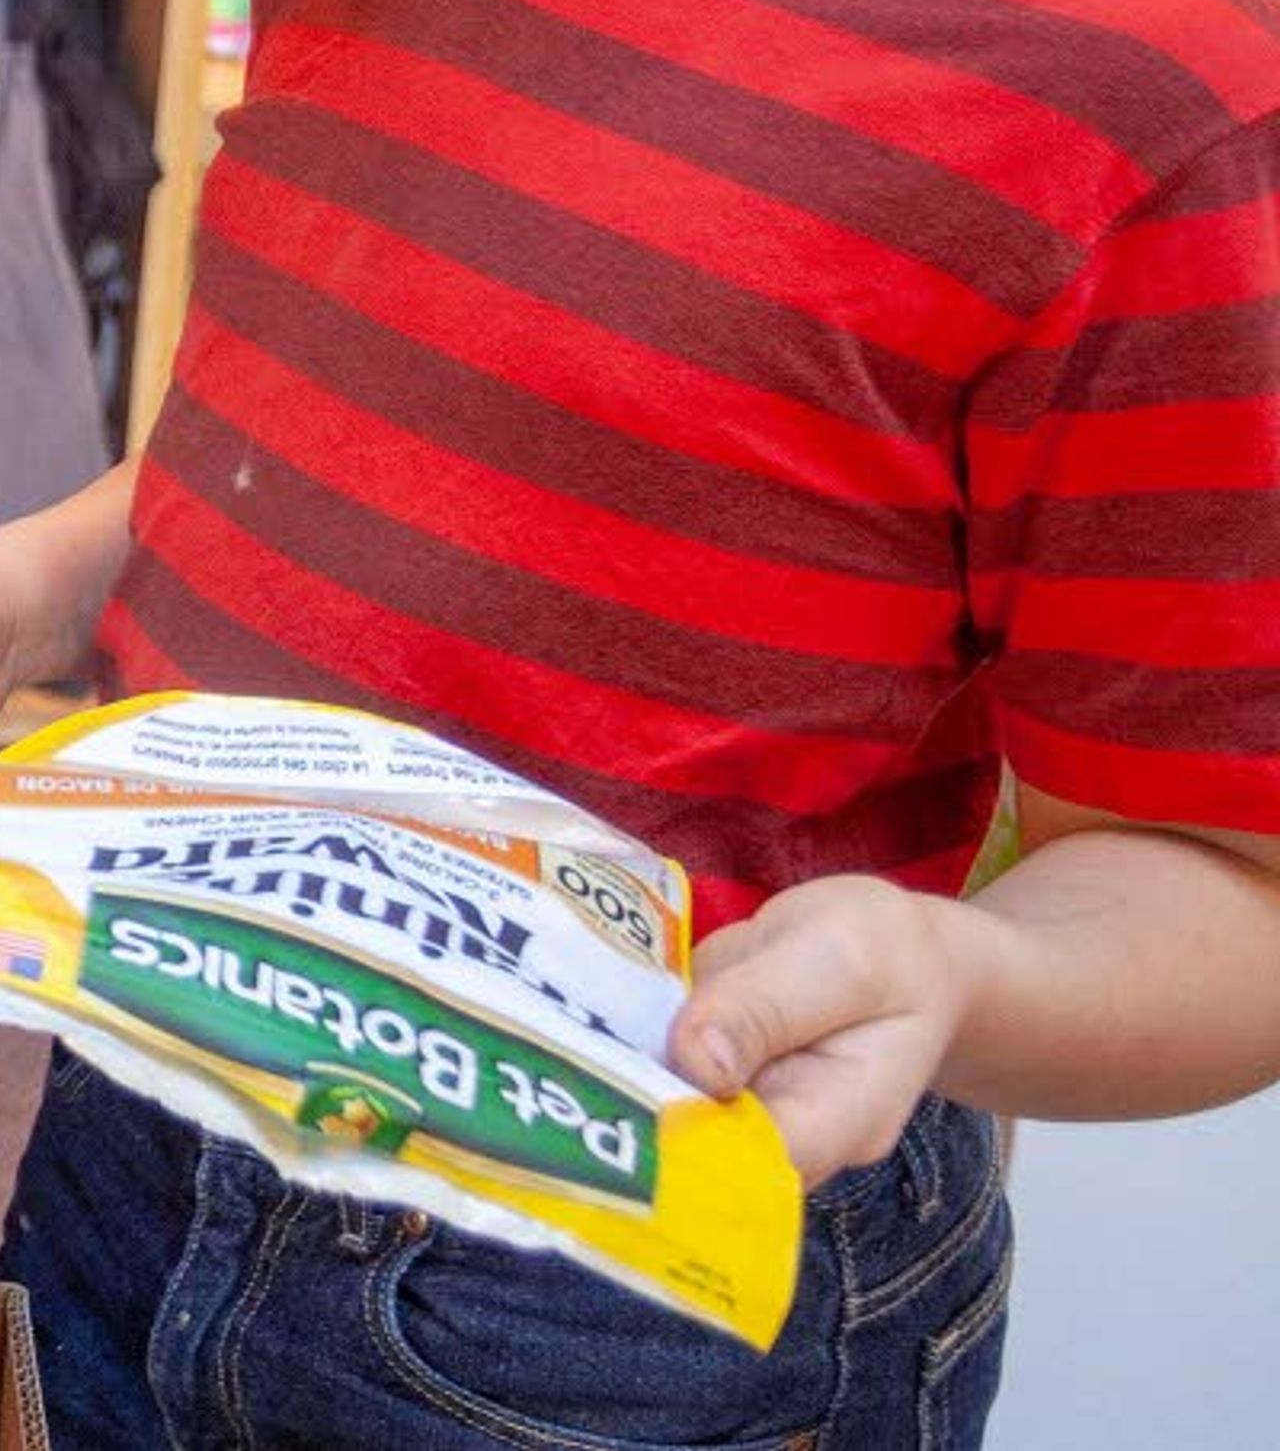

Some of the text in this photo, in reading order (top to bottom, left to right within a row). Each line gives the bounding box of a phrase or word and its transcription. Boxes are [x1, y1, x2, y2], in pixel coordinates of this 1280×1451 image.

[14, 774, 113, 795] BACON
[556, 864, 653, 951] 500
[108, 917, 479, 1111] Botanics
[494, 1060, 639, 1175] Pet
